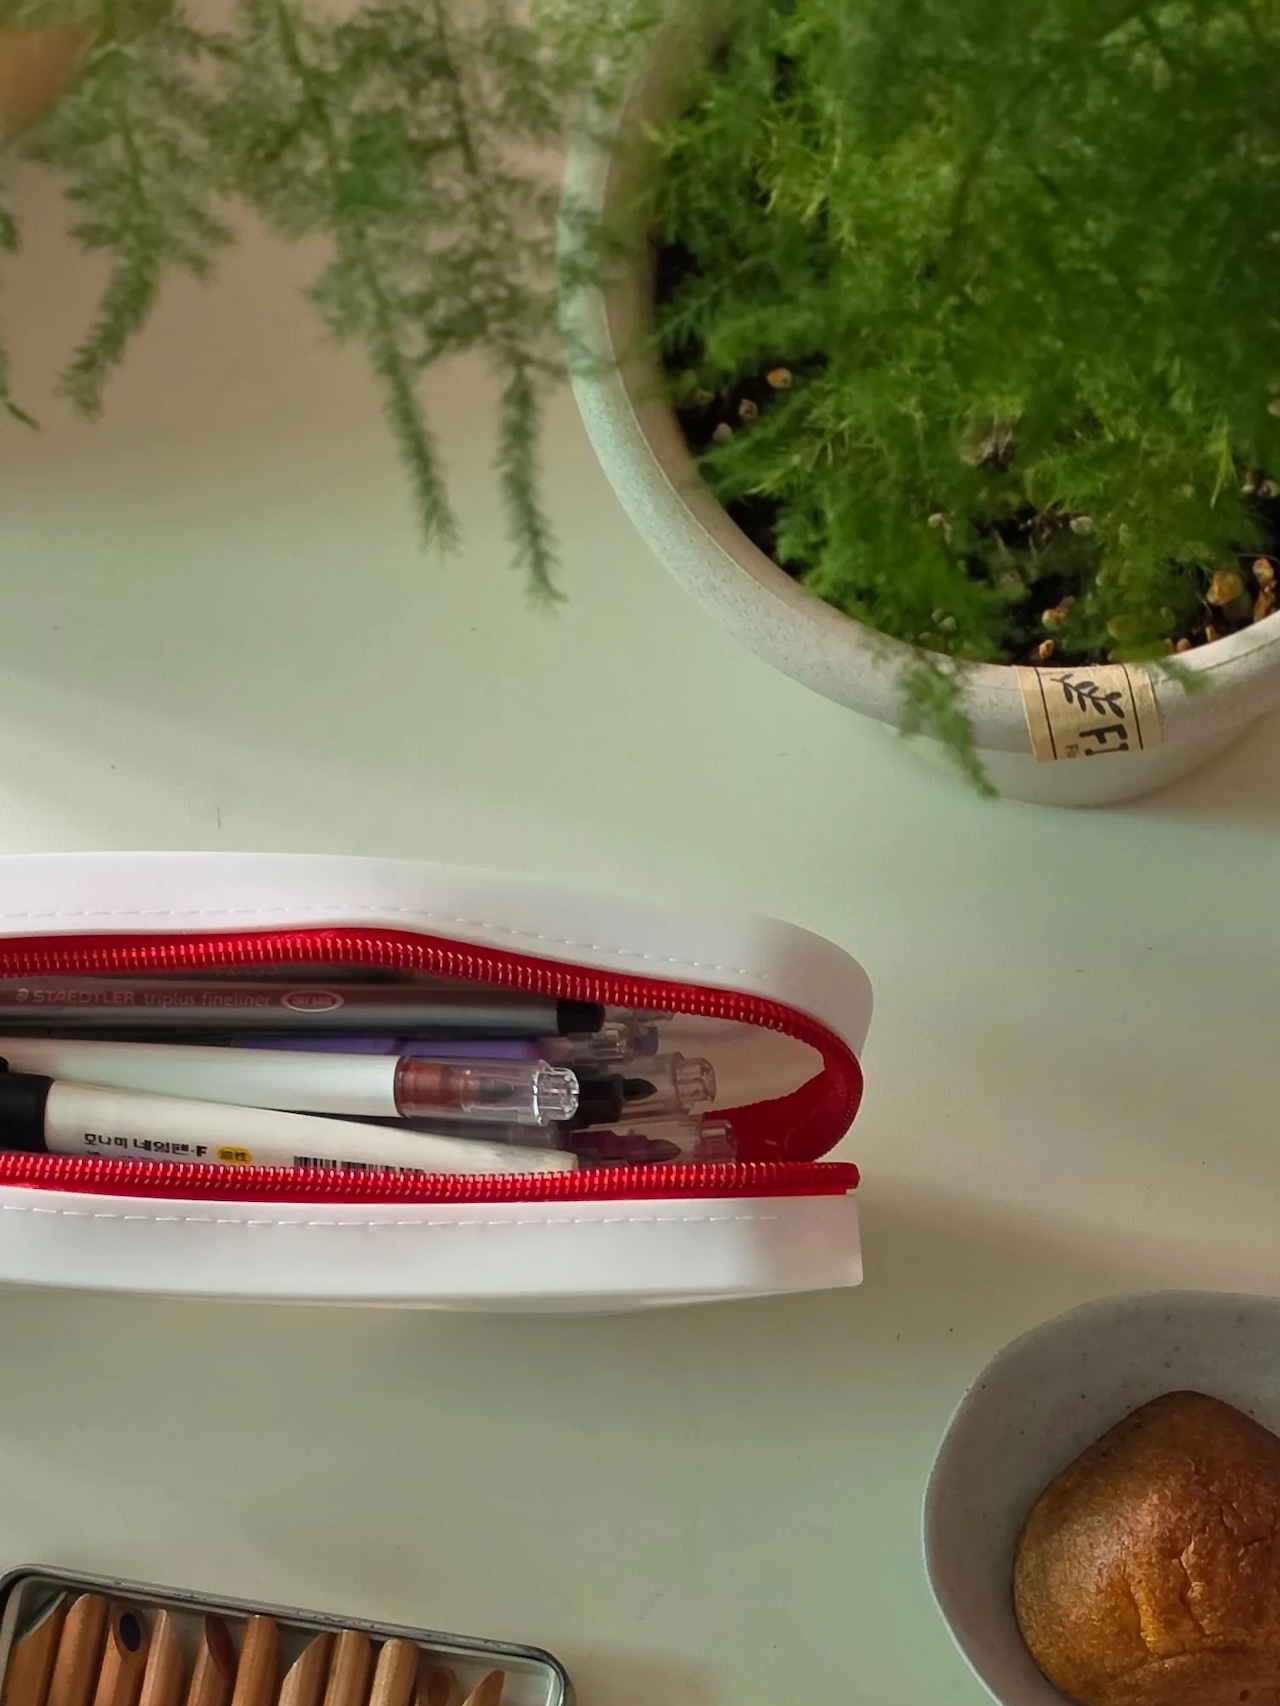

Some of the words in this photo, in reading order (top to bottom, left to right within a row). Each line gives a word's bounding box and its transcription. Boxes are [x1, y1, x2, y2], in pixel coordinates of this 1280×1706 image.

[33, 990, 135, 1004] STAEDTLER
[145, 992, 196, 1008] triplus
[202, 992, 270, 1008] fineliner
[84, 1133, 128, 1149] 모나미
